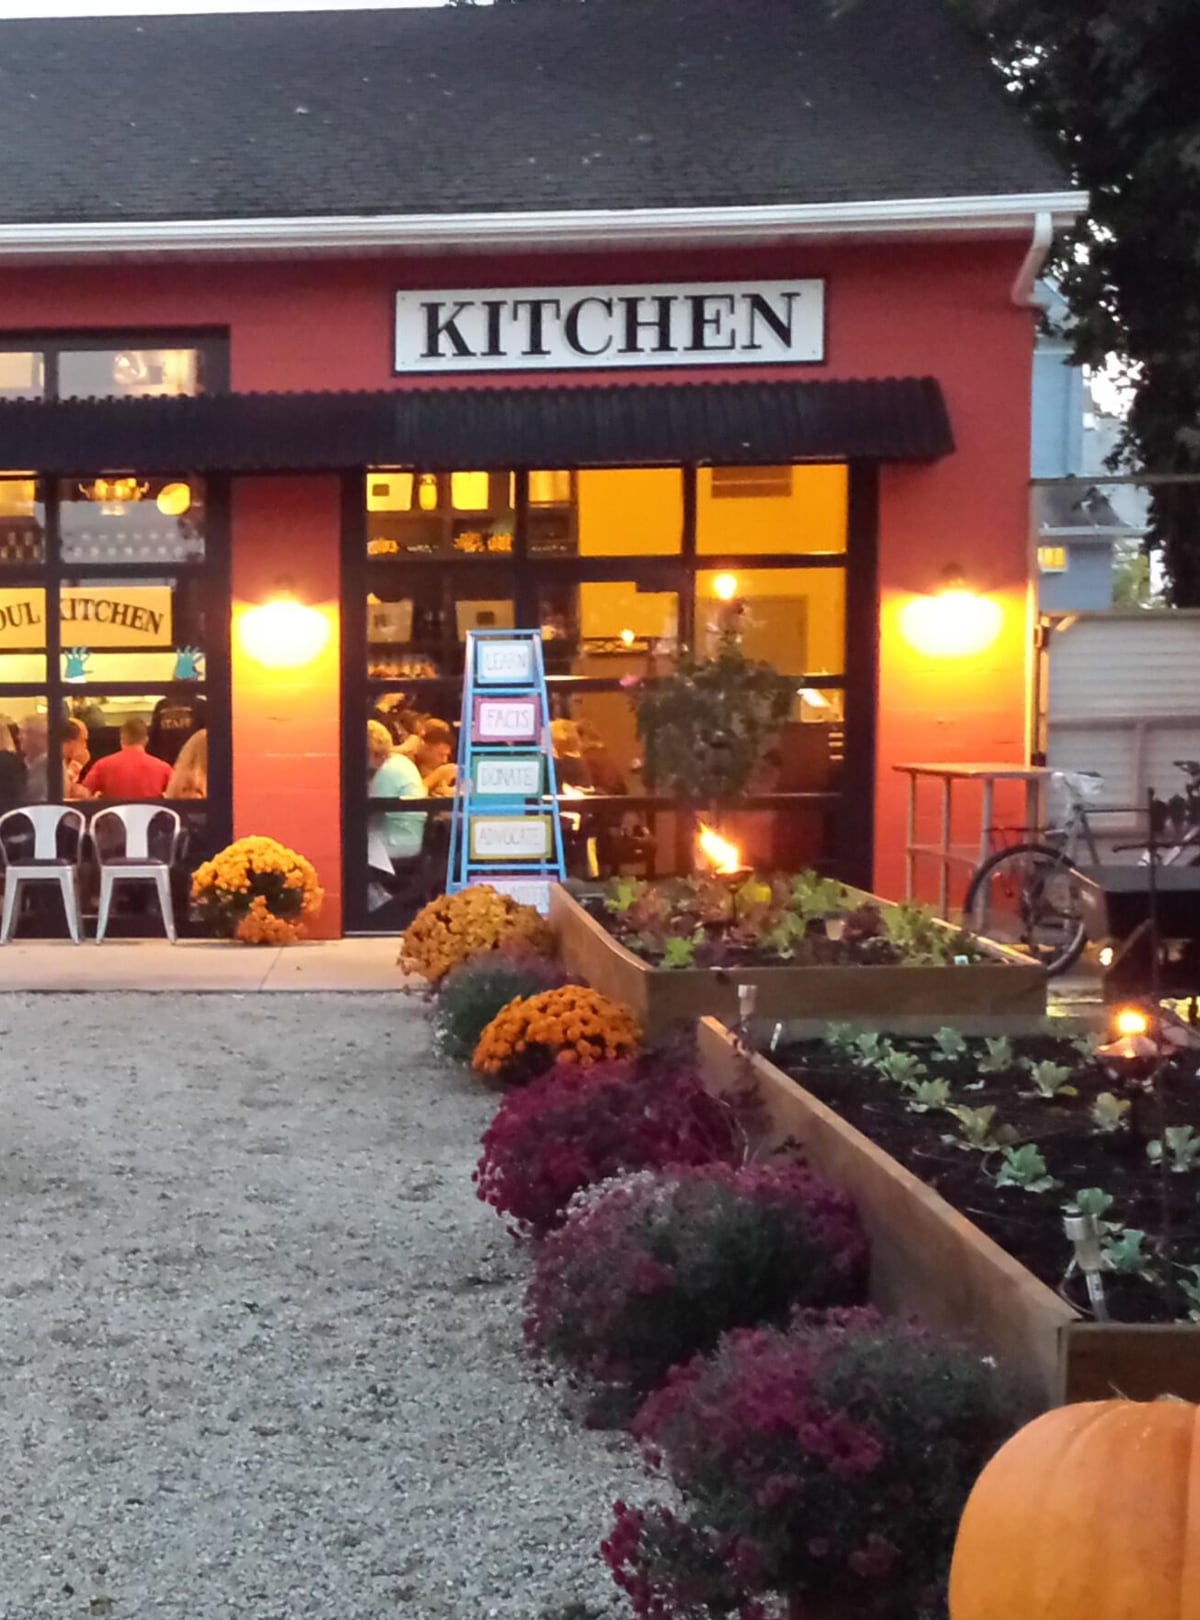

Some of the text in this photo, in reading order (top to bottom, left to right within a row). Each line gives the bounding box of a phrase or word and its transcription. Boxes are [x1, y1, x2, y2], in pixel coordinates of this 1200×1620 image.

[419, 292, 801, 358] KITCHEN
[486, 651, 527, 671] LEARN
[486, 708, 529, 729] FACTS
[480, 766, 535, 787] DONATE
[480, 827, 541, 846] ADVOCATE
